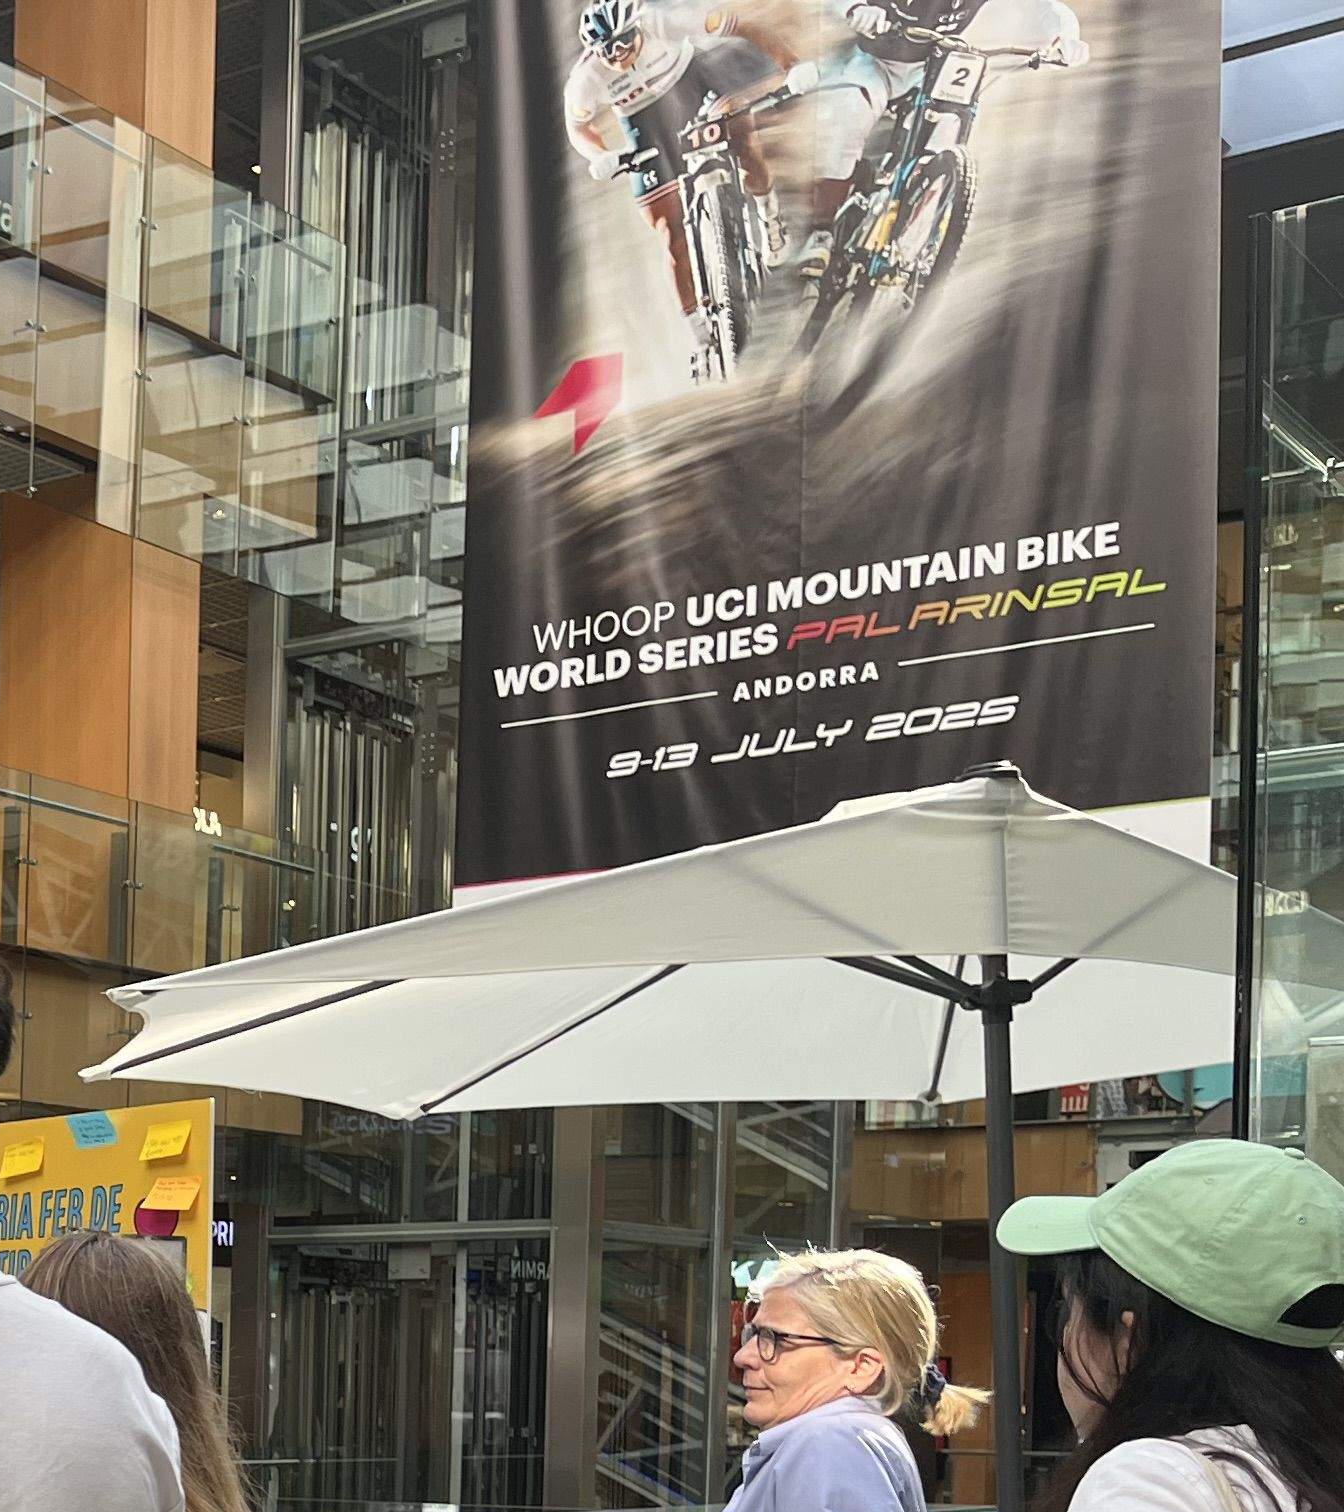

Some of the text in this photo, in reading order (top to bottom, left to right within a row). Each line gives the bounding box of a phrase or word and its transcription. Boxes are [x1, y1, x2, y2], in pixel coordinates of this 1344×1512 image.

[950, 66, 971, 87] 2
[686, 123, 721, 150] 10
[532, 521, 1121, 654] WHOOP UCI MOUNTAIN BIKE
[492, 568, 1168, 699] WORLD SERIES PAL ARINSAL
[731, 660, 880, 703] ANDORRA
[605, 694, 1021, 779] 9-13 JULY 2025
[89, 1183, 124, 1235] DE
